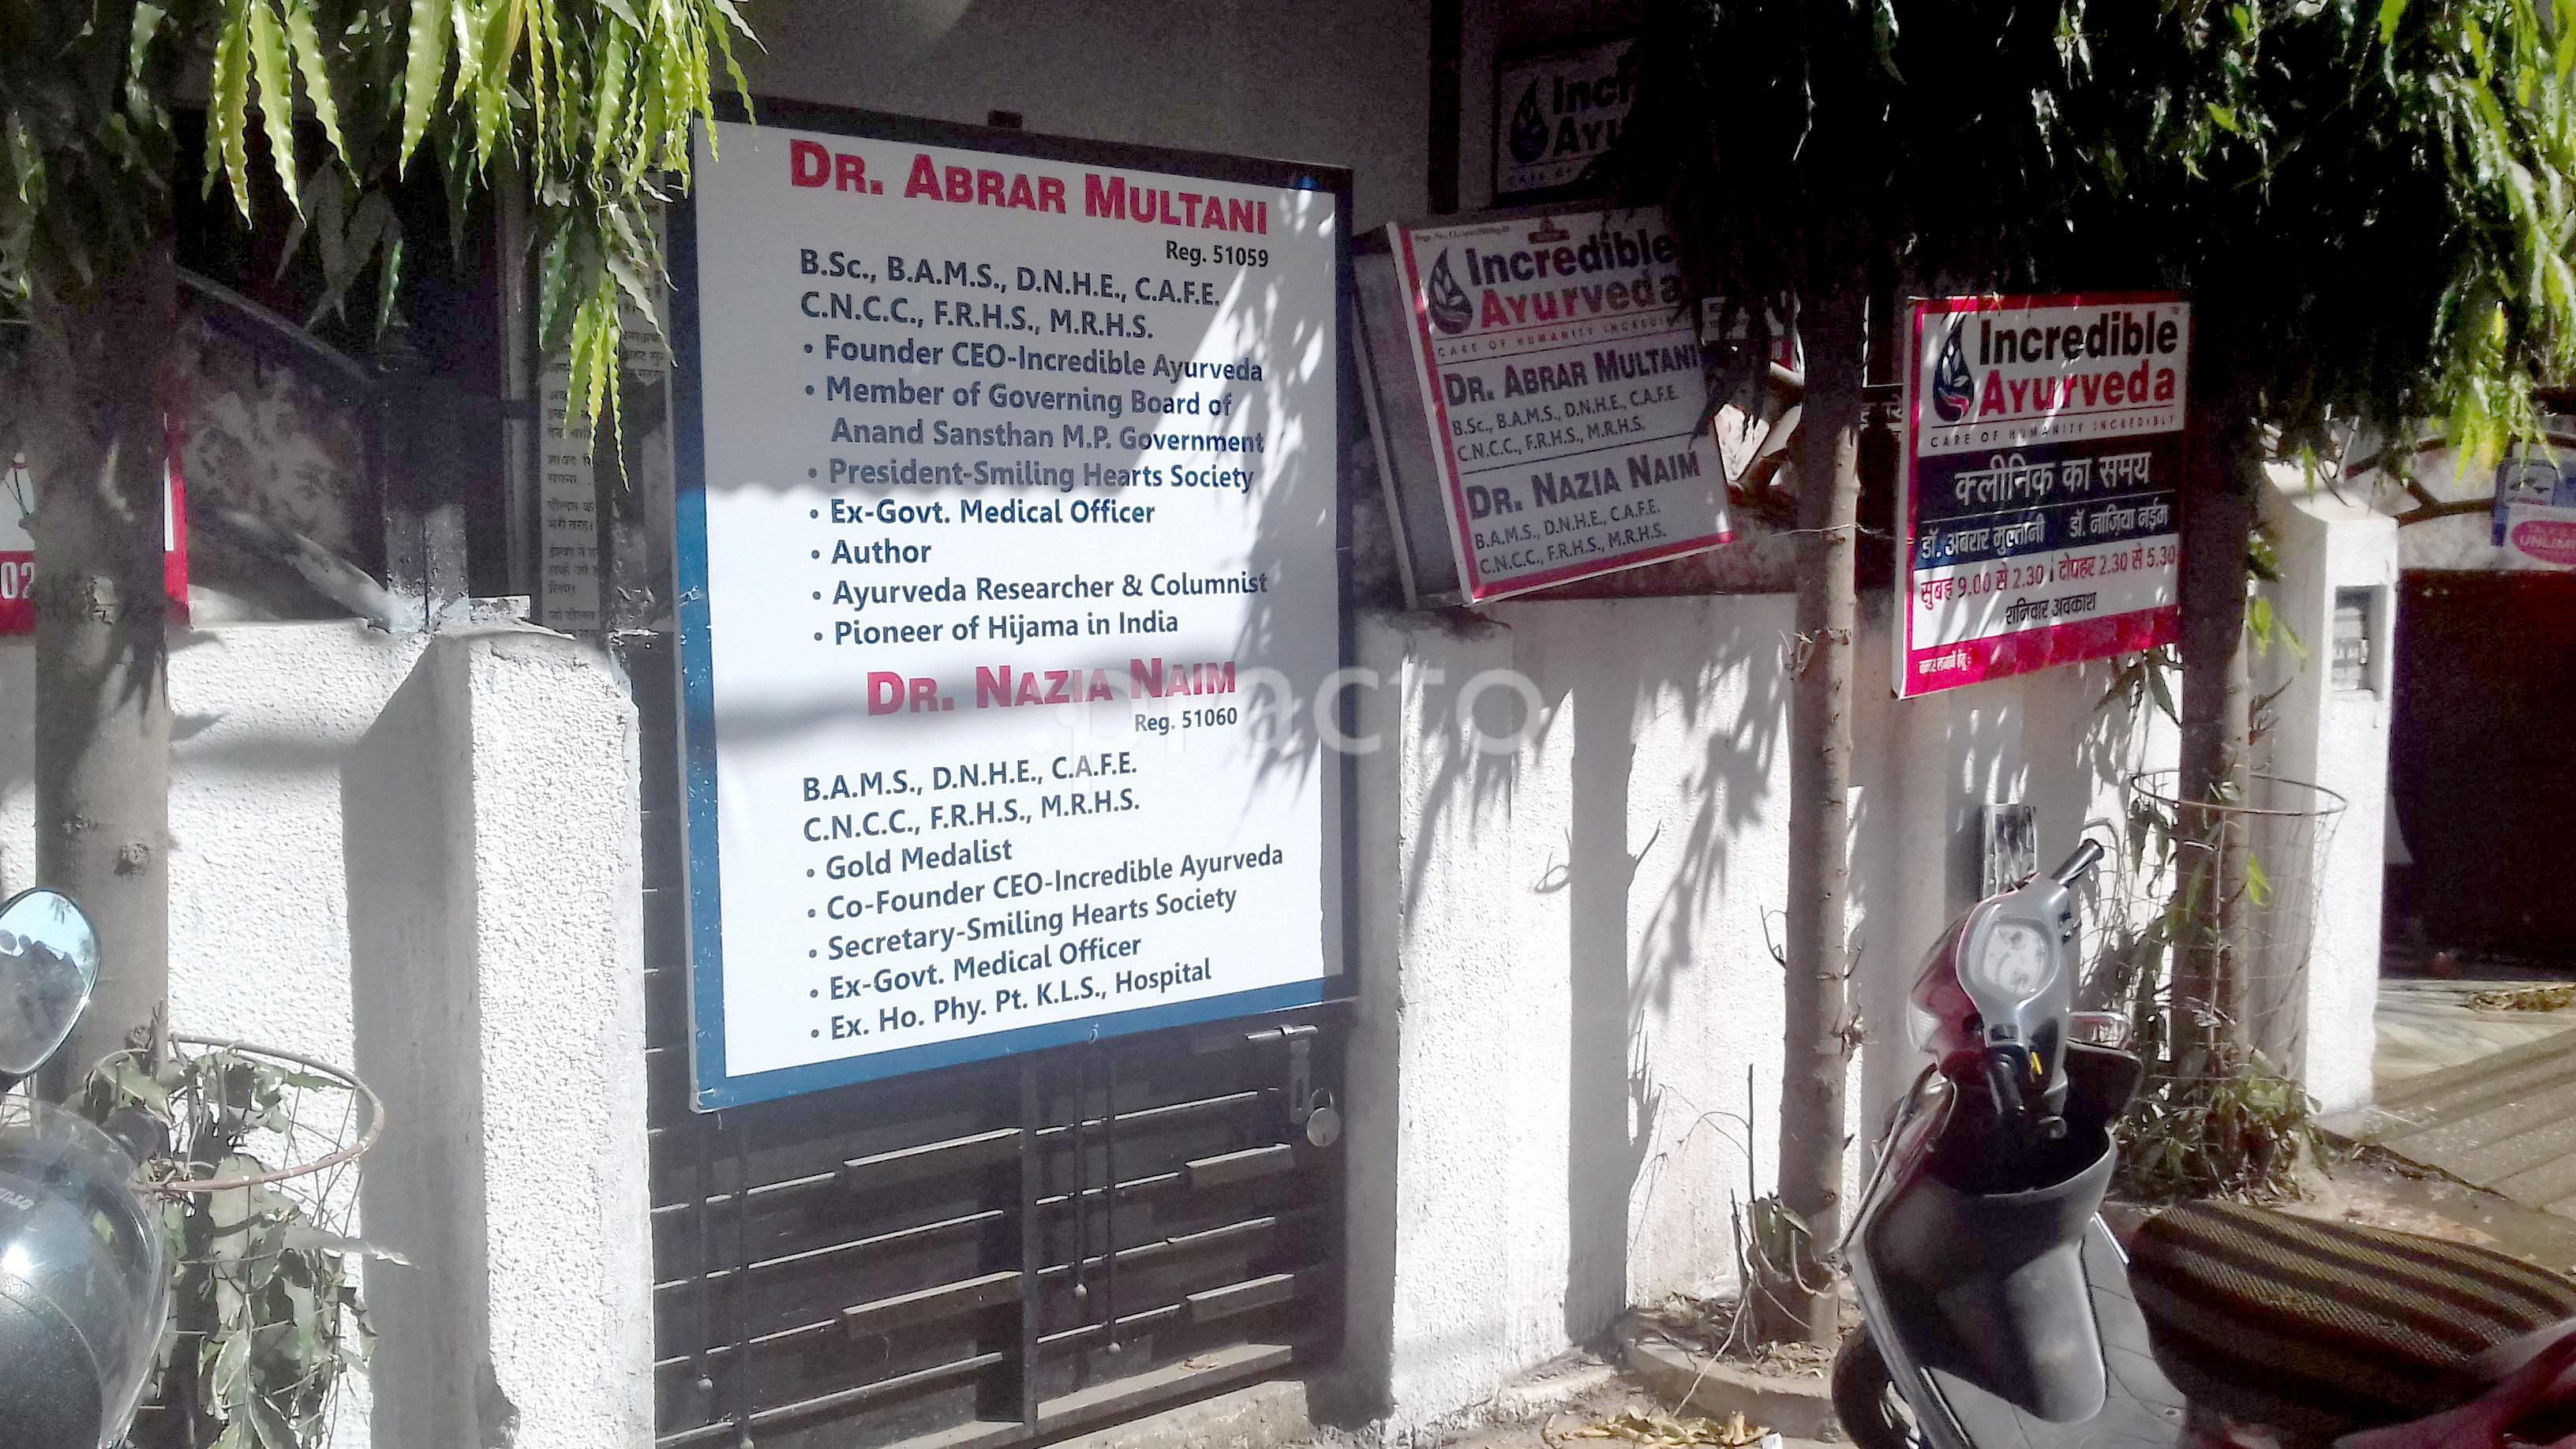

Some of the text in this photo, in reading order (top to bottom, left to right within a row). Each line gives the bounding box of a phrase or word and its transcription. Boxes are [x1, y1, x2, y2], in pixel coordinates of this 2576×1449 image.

[790, 139, 1267, 234] DR. ABRAR MULTANI
[800, 249, 1220, 306] B.Sc., B.A.M.S., D.N.H.E., C.A.F.E.
[1166, 241, 1269, 268] Reg. 51059
[1466, 229, 1675, 286] Incredible
[801, 291, 1153, 339] C.N.C.C., F.R.H.S., M.R.H.S.
[1979, 310, 2178, 365] Incredible
[826, 335, 1263, 384] Founder CEO-Incredible Ayurveda
[1505, 361, 1587, 399] ABRAR
[1593, 342, 1699, 384] MULTANI
[826, 376, 1232, 419] Member of Governing Board of
[1979, 358, 2175, 417] Ayurveda
[831, 417, 1264, 454] Anand Sansthan M.P. Government
[1930, 434, 1971, 447] CARE
[1981, 431, 1998, 443] OF
[829, 458, 1254, 493] President-Smiling Hearts Society
[1531, 467, 1622, 508] NAZIA
[1627, 451, 1702, 489] NAIM
[2061, 458, 2092, 493] का
[2099, 451, 2152, 489] समय
[831, 498, 1155, 524] Ex-Govt. Medical Officer
[831, 537, 932, 564] Author
[833, 571, 1268, 612] Ayurveda Researcher & Columnist
[1921, 578, 1954, 611] सुबह
[1958, 572, 1991, 598] 9.00
[2014, 564, 2044, 589] 2.30
[2099, 552, 2128, 575] 2.30
[2147, 545, 2176, 568] 5.30
[835, 609, 1178, 646] Pioneer of Hijama in India
[867, 657, 1236, 716] DR. NAZIA NAIM
[1135, 707, 1237, 736] Reg. 51060
[803, 751, 1137, 802] B.A.M.S., D.N.H.E., C.A.F.E.
[803, 788, 1140, 842] C.N.C.C., F.R.H.S., M.R.H.S.
[826, 839, 1013, 880] Gold Medalist
[827, 844, 1283, 919] Co-Founder CEO-Incredible Ayurveda
[829, 888, 1237, 960] Secretary-Smiling Hearts Society
[830, 937, 1142, 1000] Ex-Govt. Medical Officer
[831, 957, 1212, 1040] Ex. Ho. Phy. Pt. K.L.S., Hospital
